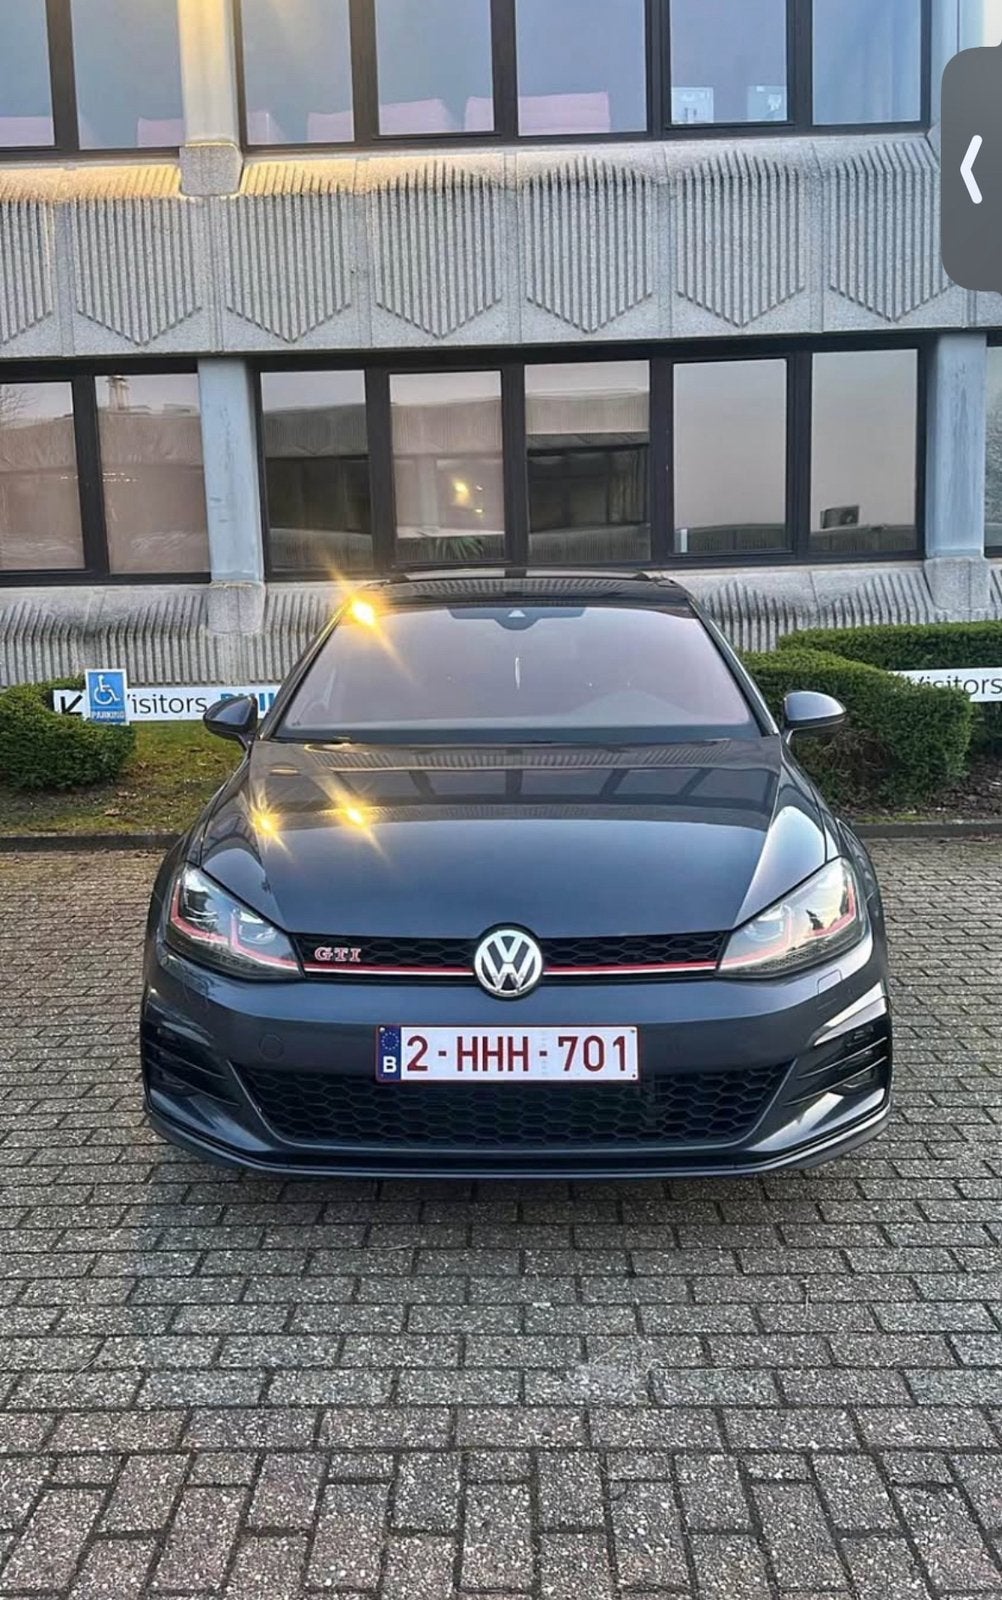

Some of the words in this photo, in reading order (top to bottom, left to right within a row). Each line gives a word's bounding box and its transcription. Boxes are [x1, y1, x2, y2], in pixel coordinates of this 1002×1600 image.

[127, 694, 207, 714] isitors
[314, 946, 362, 963] GTI
[406, 1035, 627, 1072] 2-HHH-701
[382, 1055, 397, 1073] B
